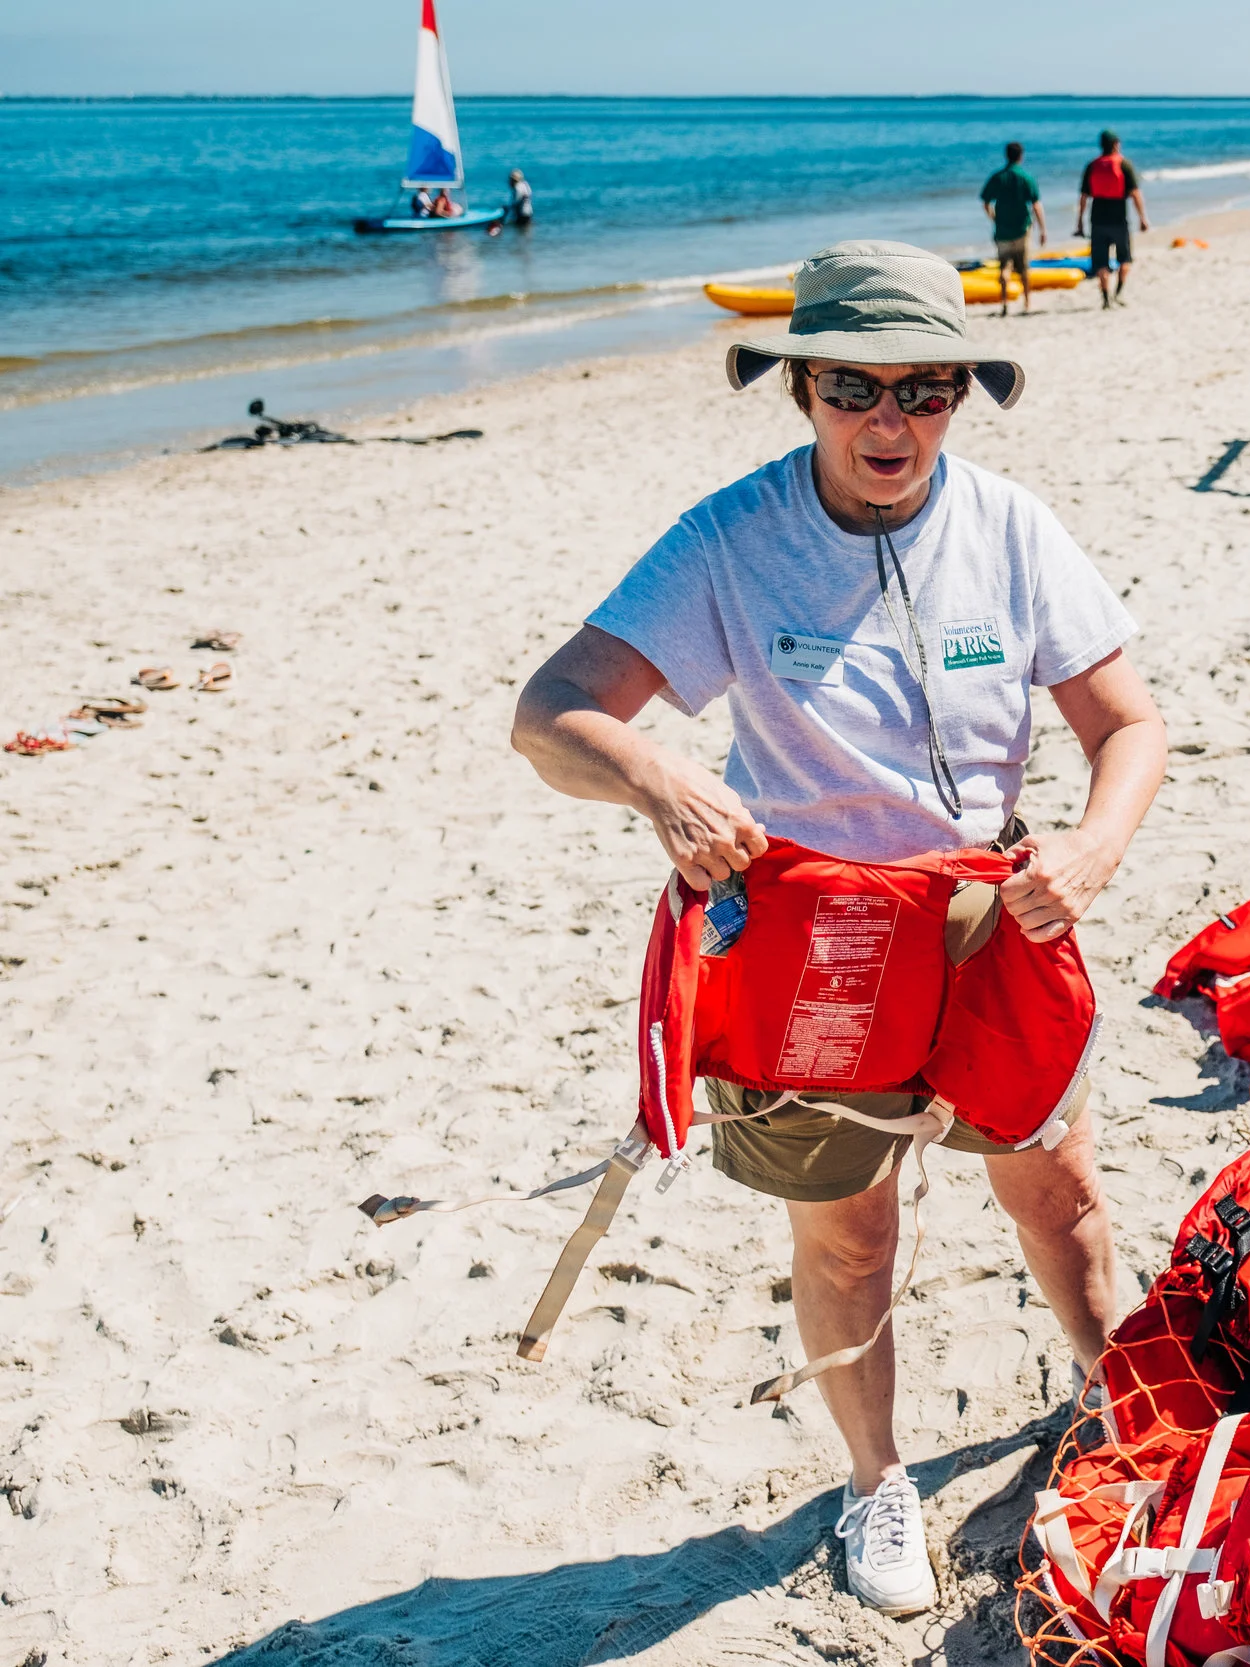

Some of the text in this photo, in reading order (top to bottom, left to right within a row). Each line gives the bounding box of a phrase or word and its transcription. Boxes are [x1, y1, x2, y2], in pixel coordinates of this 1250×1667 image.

[943, 625, 982, 636] Volunteers
[797, 643, 841, 655] VOLUNTEER
[943, 633, 1001, 658] PARKS
[792, 660, 826, 671] Annie Kelly
